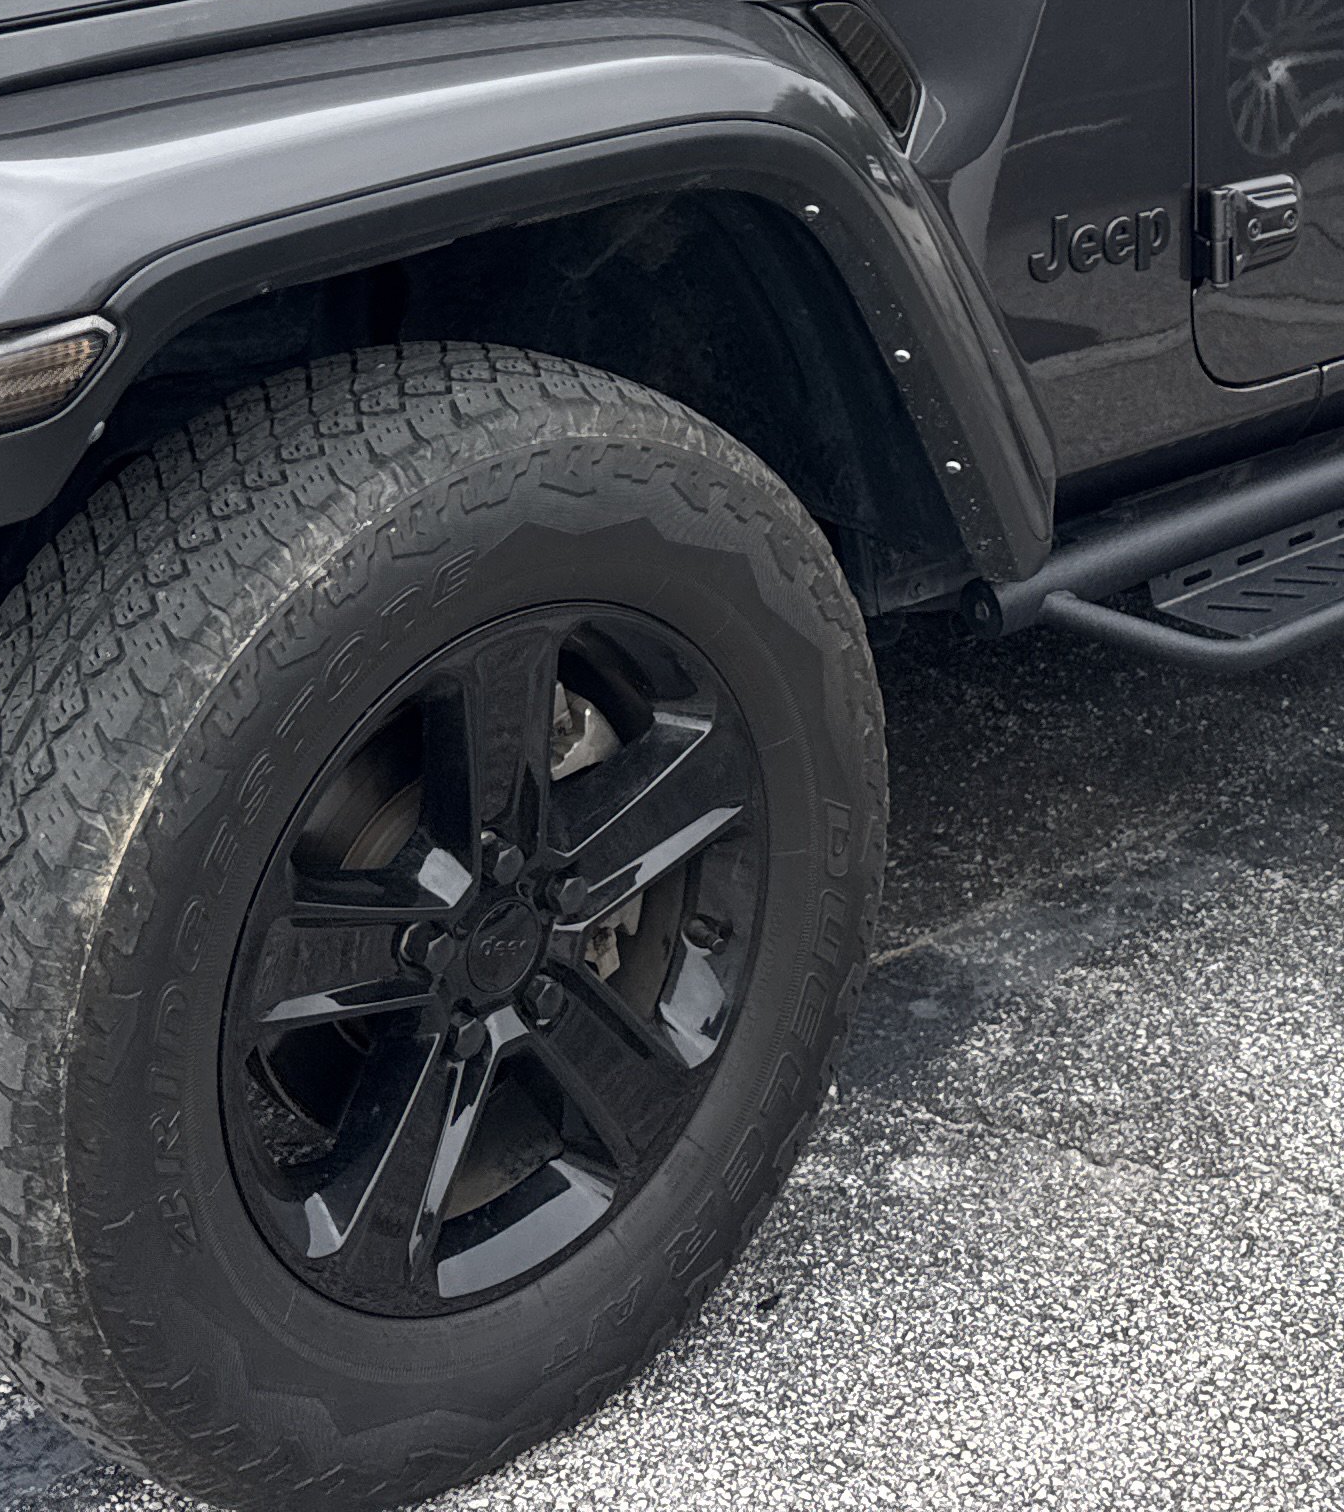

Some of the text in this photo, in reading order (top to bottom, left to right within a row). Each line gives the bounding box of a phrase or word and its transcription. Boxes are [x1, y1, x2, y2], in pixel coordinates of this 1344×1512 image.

[1027, 207, 1172, 284] Jeep
[149, 548, 477, 1256] BRIDGESTONE
[663, 797, 853, 1279] DUELER
